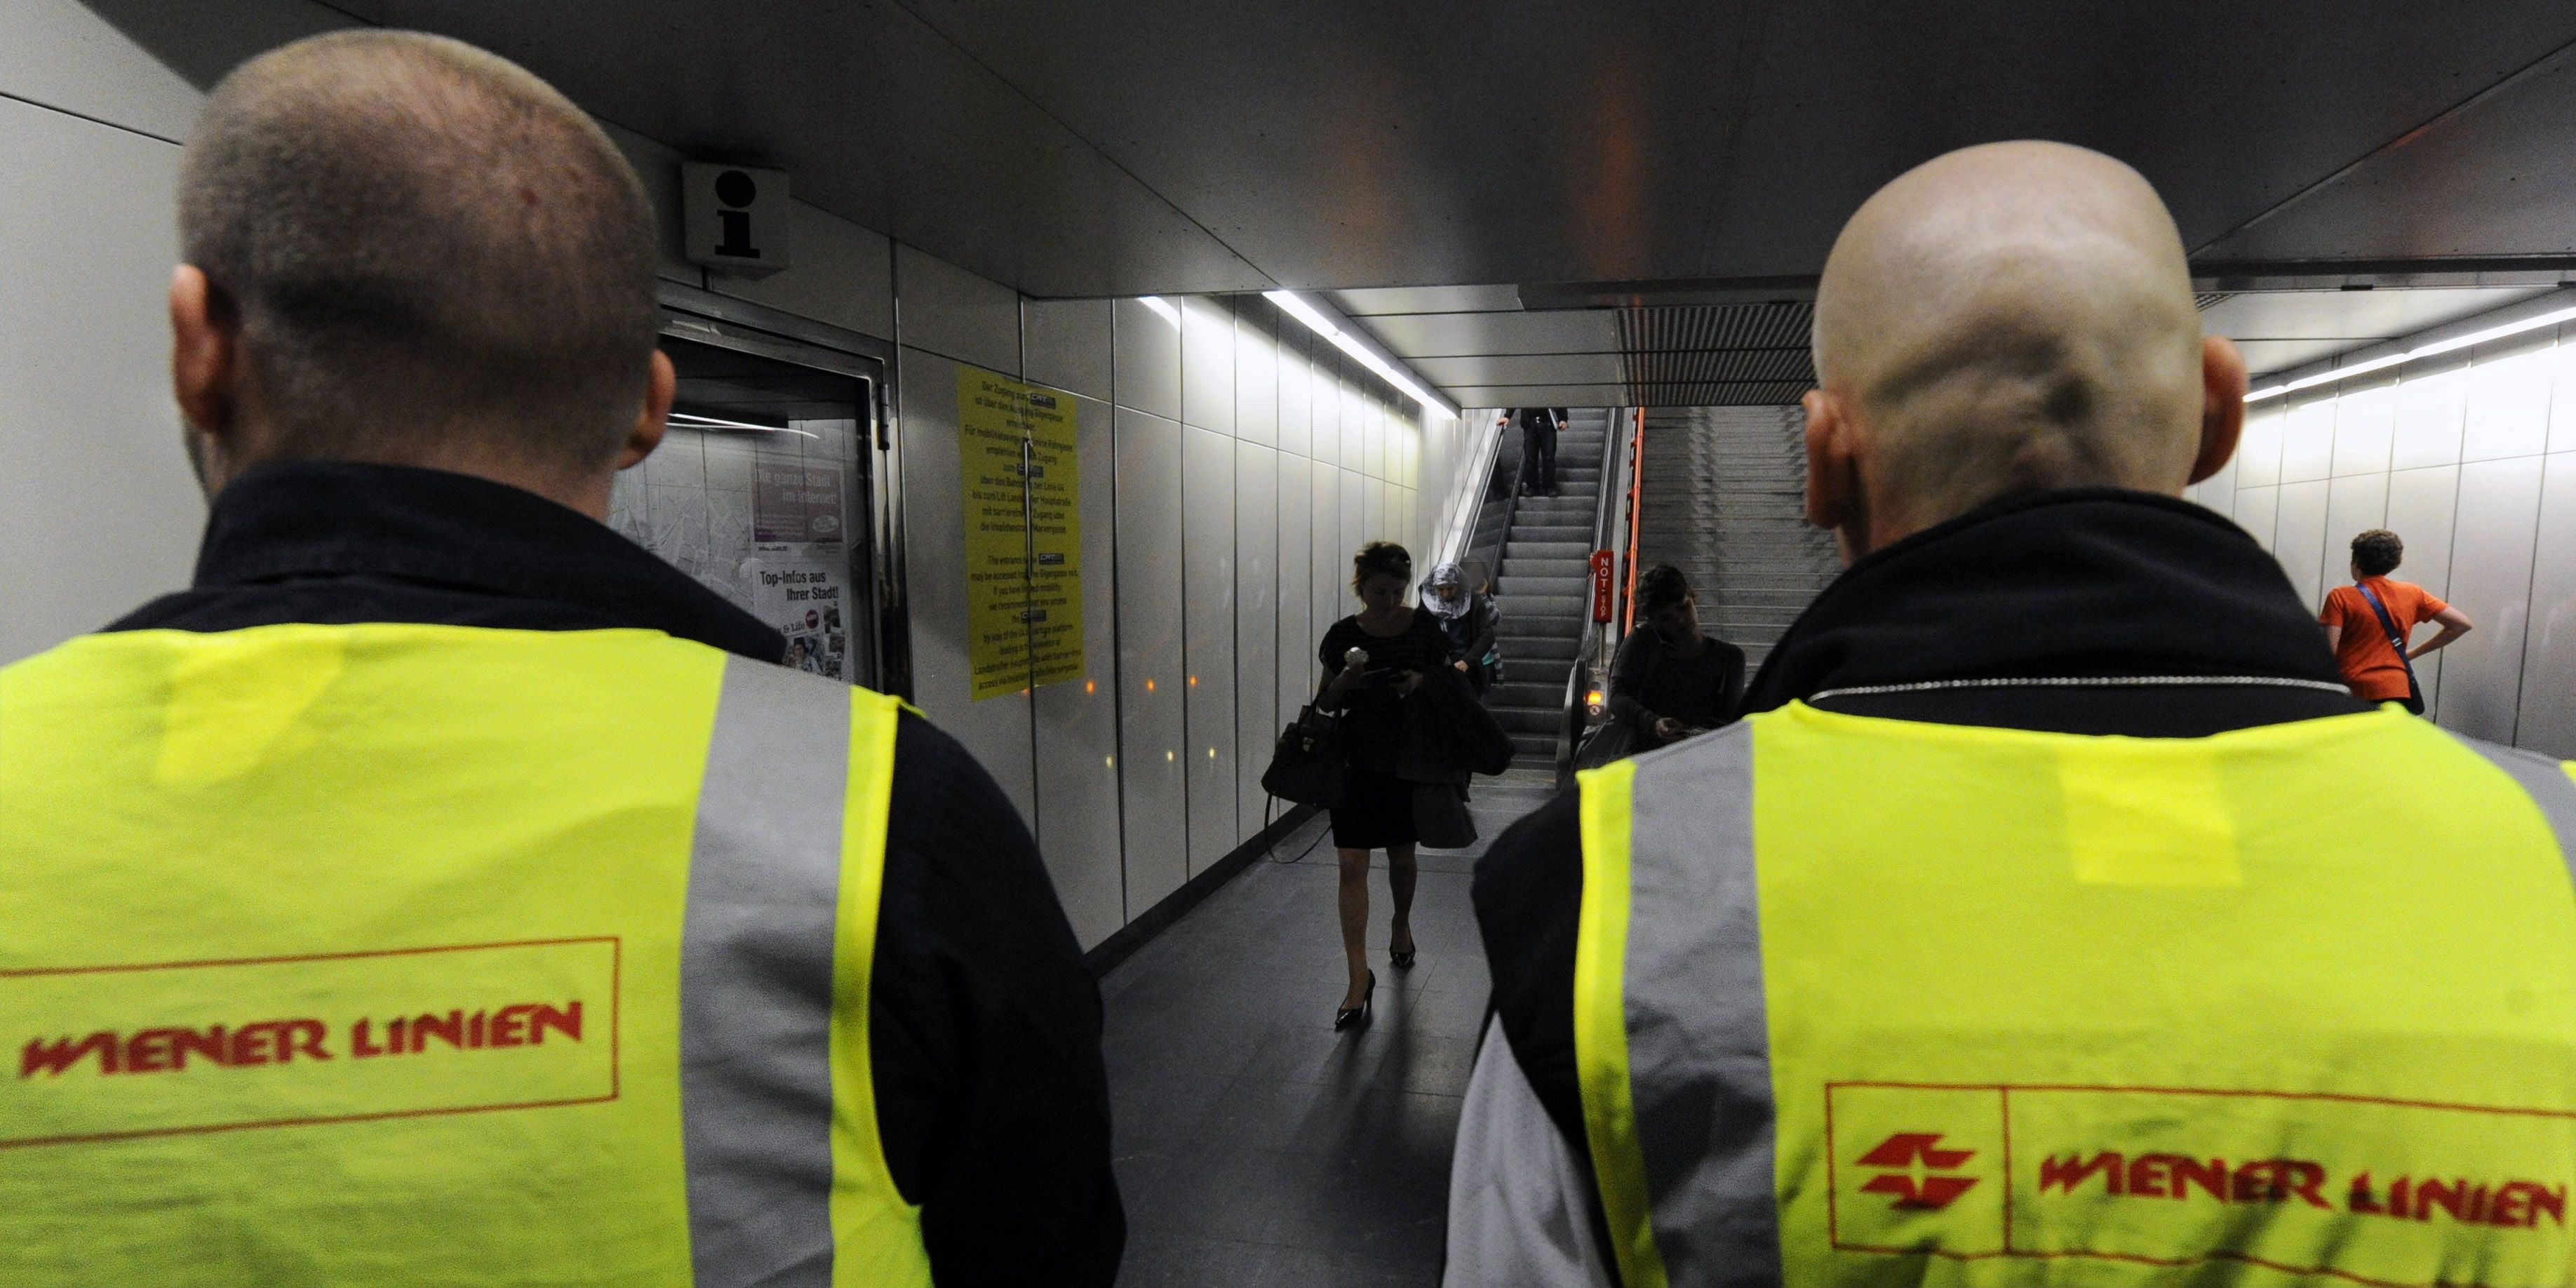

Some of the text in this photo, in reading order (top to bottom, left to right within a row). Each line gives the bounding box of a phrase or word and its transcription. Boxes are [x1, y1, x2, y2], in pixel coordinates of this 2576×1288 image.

[760, 570, 826, 587] Top-Infos aus
[786, 586, 839, 601] Ihrer Stadt!
[791, 621, 805, 631] Life
[20, 1000, 583, 1079] WIENER LINIEN
[2039, 1151, 2568, 1230] WIENER LINIEN
